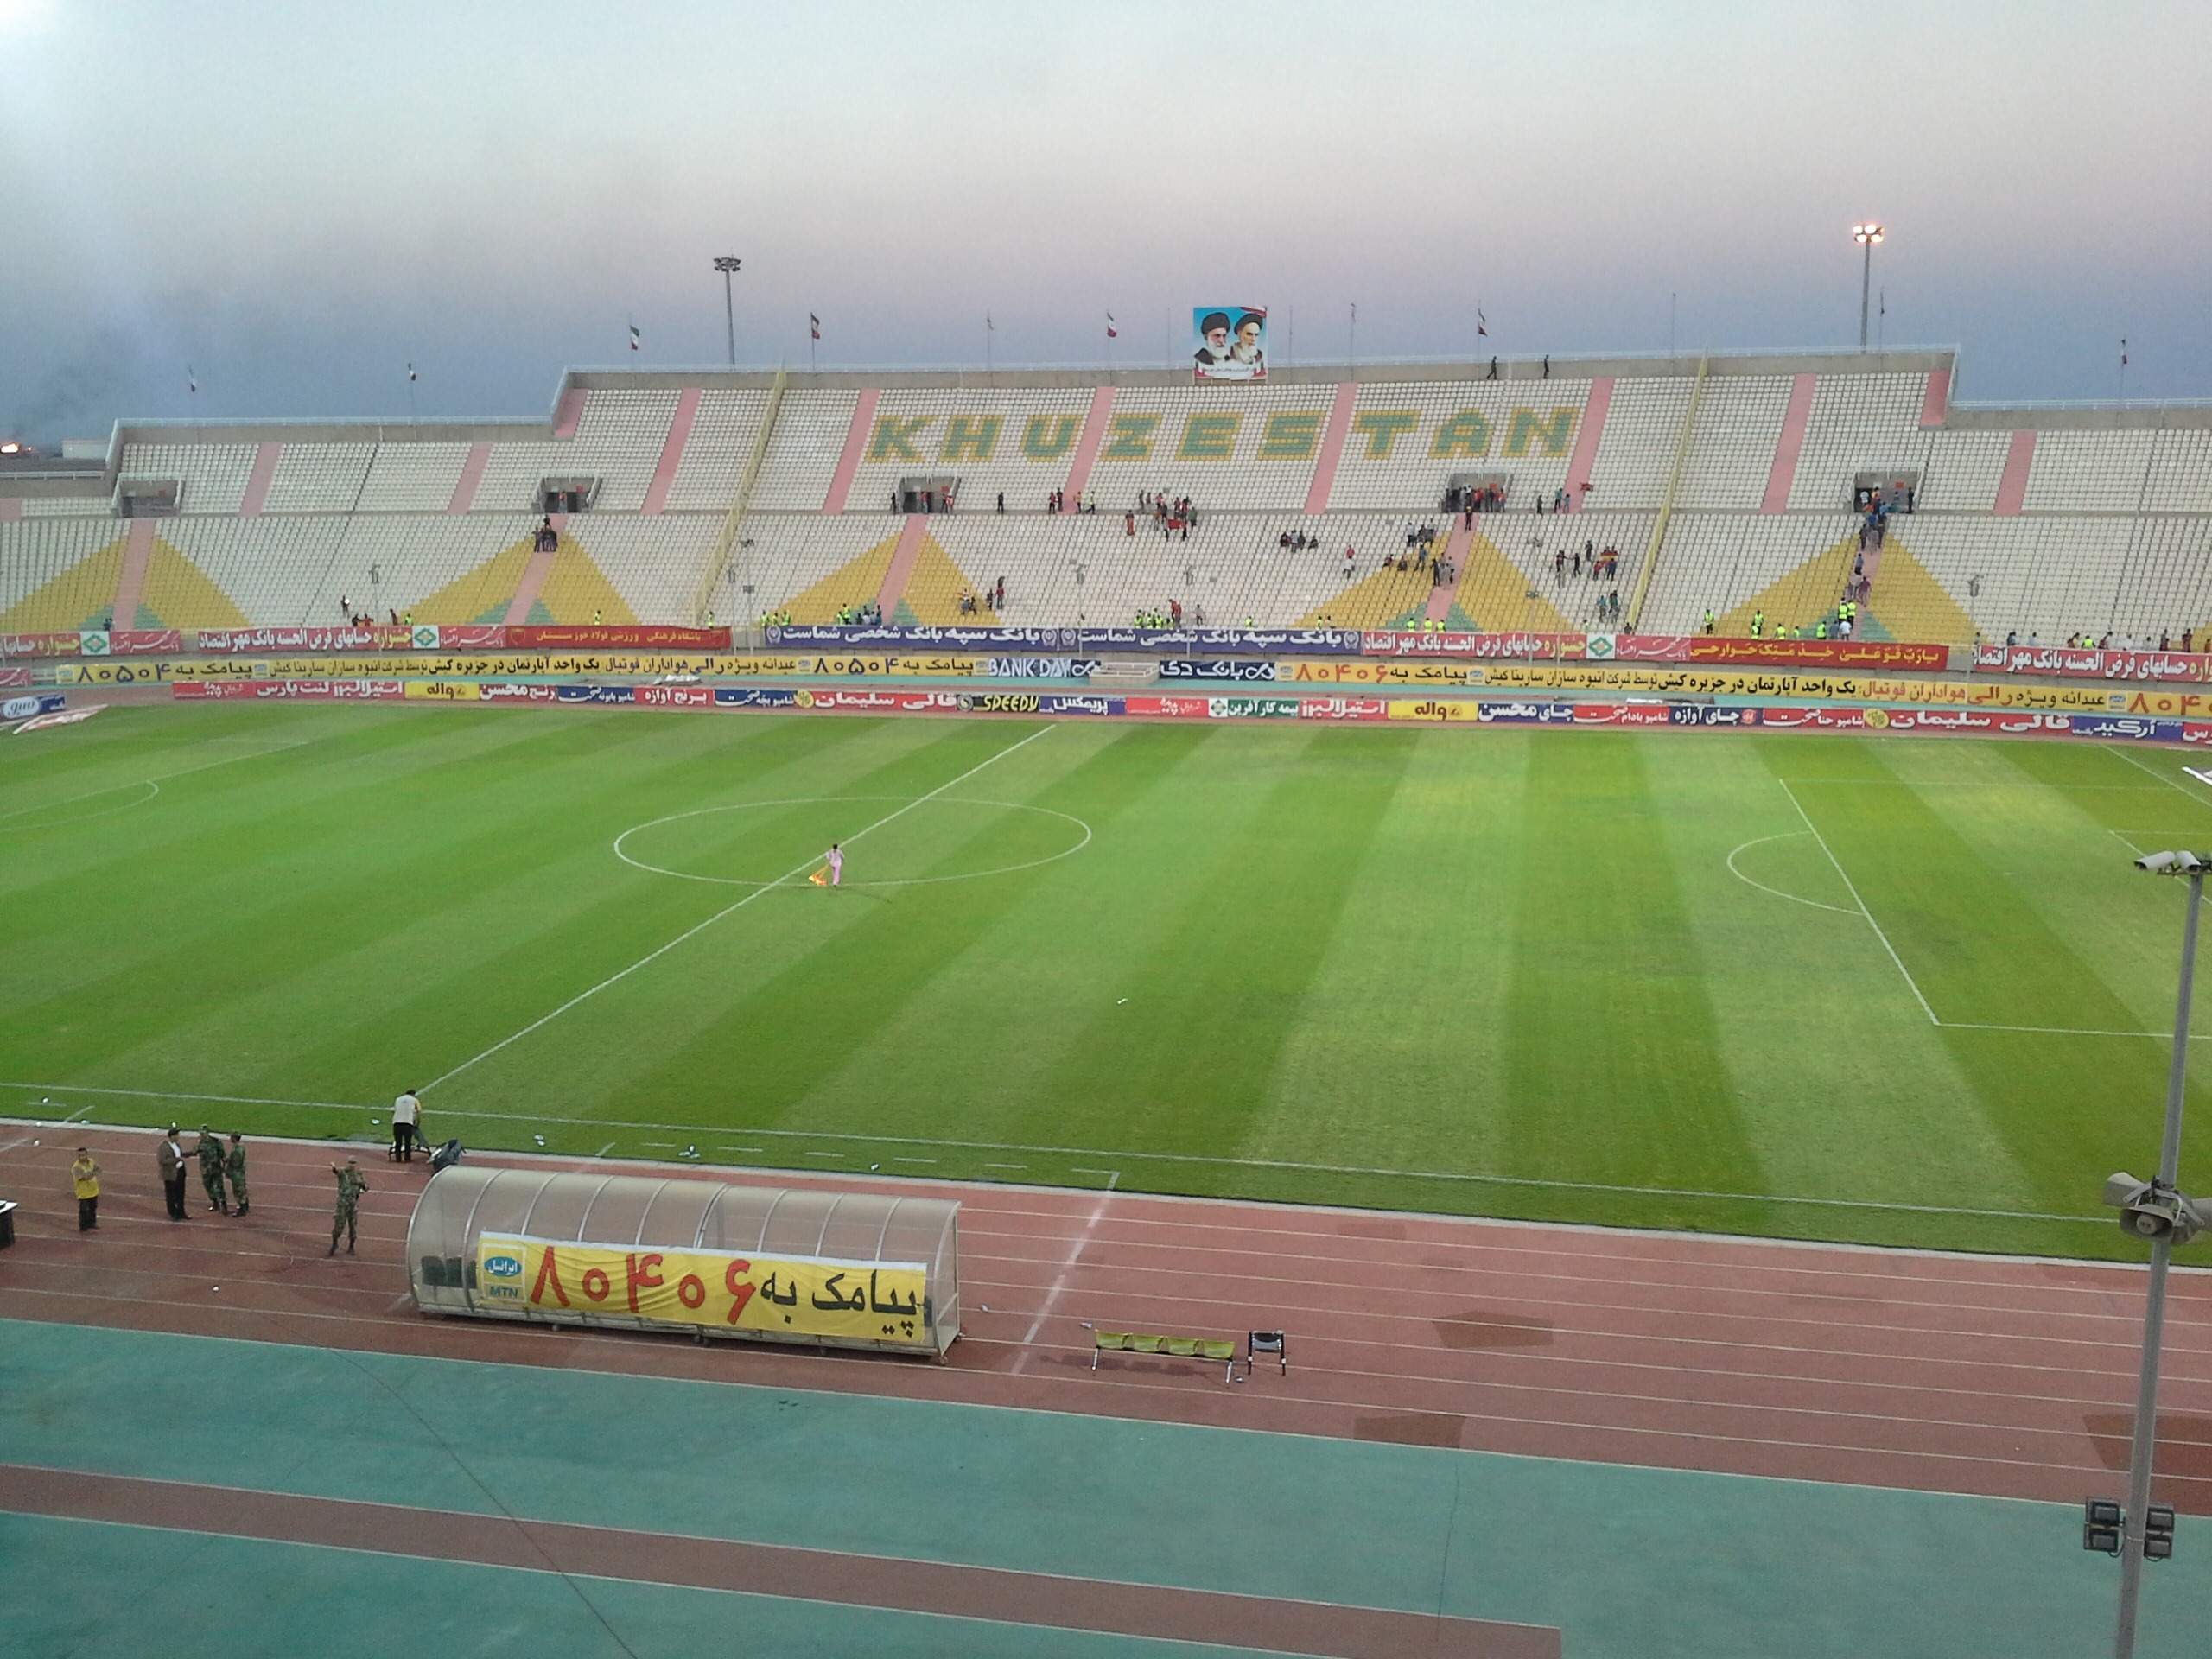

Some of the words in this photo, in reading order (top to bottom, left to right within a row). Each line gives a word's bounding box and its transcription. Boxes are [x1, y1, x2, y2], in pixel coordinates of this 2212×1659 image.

[866, 406, 1580, 462] KHUZESTAN
[198, 632, 230, 649] اقتصاد
[251, 629, 275, 650] بانک
[276, 629, 308, 645] الحسنه
[308, 629, 333, 650] قرض
[783, 626, 841, 639] شماست
[845, 626, 900, 642] شخصی
[906, 626, 943, 643] بانک
[945, 627, 987, 645] سپه
[990, 628, 1040, 645] بانک
[1077, 629, 1136, 642] شماست
[1141, 629, 1198, 645] شخصی
[1202, 630, 1240, 646] بانک
[1243, 632, 1287, 648] سپه
[1289, 631, 1342, 648] بانک
[1365, 632, 1395, 650] اقتصاد
[231, 633, 251, 652] مهر
[1395, 635, 1416, 655] مهر
[1417, 634, 1441, 654] بانک
[1443, 636, 1475, 651] الحسنه
[1476, 635, 1501, 657] قرض
[200, 661, 253, 680] پیامک
[270, 662, 291, 677] کیش
[429, 658, 454, 675] کیش
[457, 660, 488, 674] جزیره
[493, 660, 504, 674] در
[507, 657, 550, 675] آپارتمان
[554, 658, 581, 673] واحد
[583, 658, 600, 673] یک
[727, 658, 759, 675] ویژه
[903, 660, 920, 675] به
[925, 658, 974, 677] پیامک
[988, 658, 1035, 677] BANK
[1039, 658, 1071, 677] DAY
[1160, 660, 1192, 676] دی
[1196, 660, 1244, 681] بانک
[2006, 652, 2032, 672] مهر
[2033, 650, 2063, 674] بانک
[2065, 652, 2104, 671] الحسنه
[2105, 652, 2136, 678] قرض
[2137, 654, 2187, 679] حسابهای
[175, 665, 194, 680] به
[1389, 667, 1408, 683] به
[1415, 666, 1467, 685] پیامک
[1484, 668, 1509, 686] کیش
[1606, 671, 1631, 690] شرکت
[1658, 673, 1687, 690] کیش
[1689, 677, 1726, 693] جزیره
[1729, 678, 1744, 693] در
[1746, 676, 1799, 696] آپارتمان
[1802, 679, 1833, 697] واحد
[1836, 680, 1856, 697] یک
[645, 687, 672, 704] آوازه
[674, 690, 708, 704] برنج
[815, 691, 895, 709] سلیمان
[984, 695, 1039, 712] SPEEDY
[2016, 690, 2056, 709] ویژه
[1278, 703, 1299, 716] بیمه
[1414, 702, 1447, 721] واله
[1478, 702, 1537, 721] محسن
[1539, 703, 1573, 722] چای
[1675, 706, 1706, 725] آوازه
[1706, 708, 1739, 726] چای
[1891, 710, 1991, 729] سلیمان
[2000, 715, 2070, 732] قالی
[490, 1286, 518, 1297] MTN
[760, 1272, 797, 1324] به
[812, 1269, 917, 1338] پیامک
